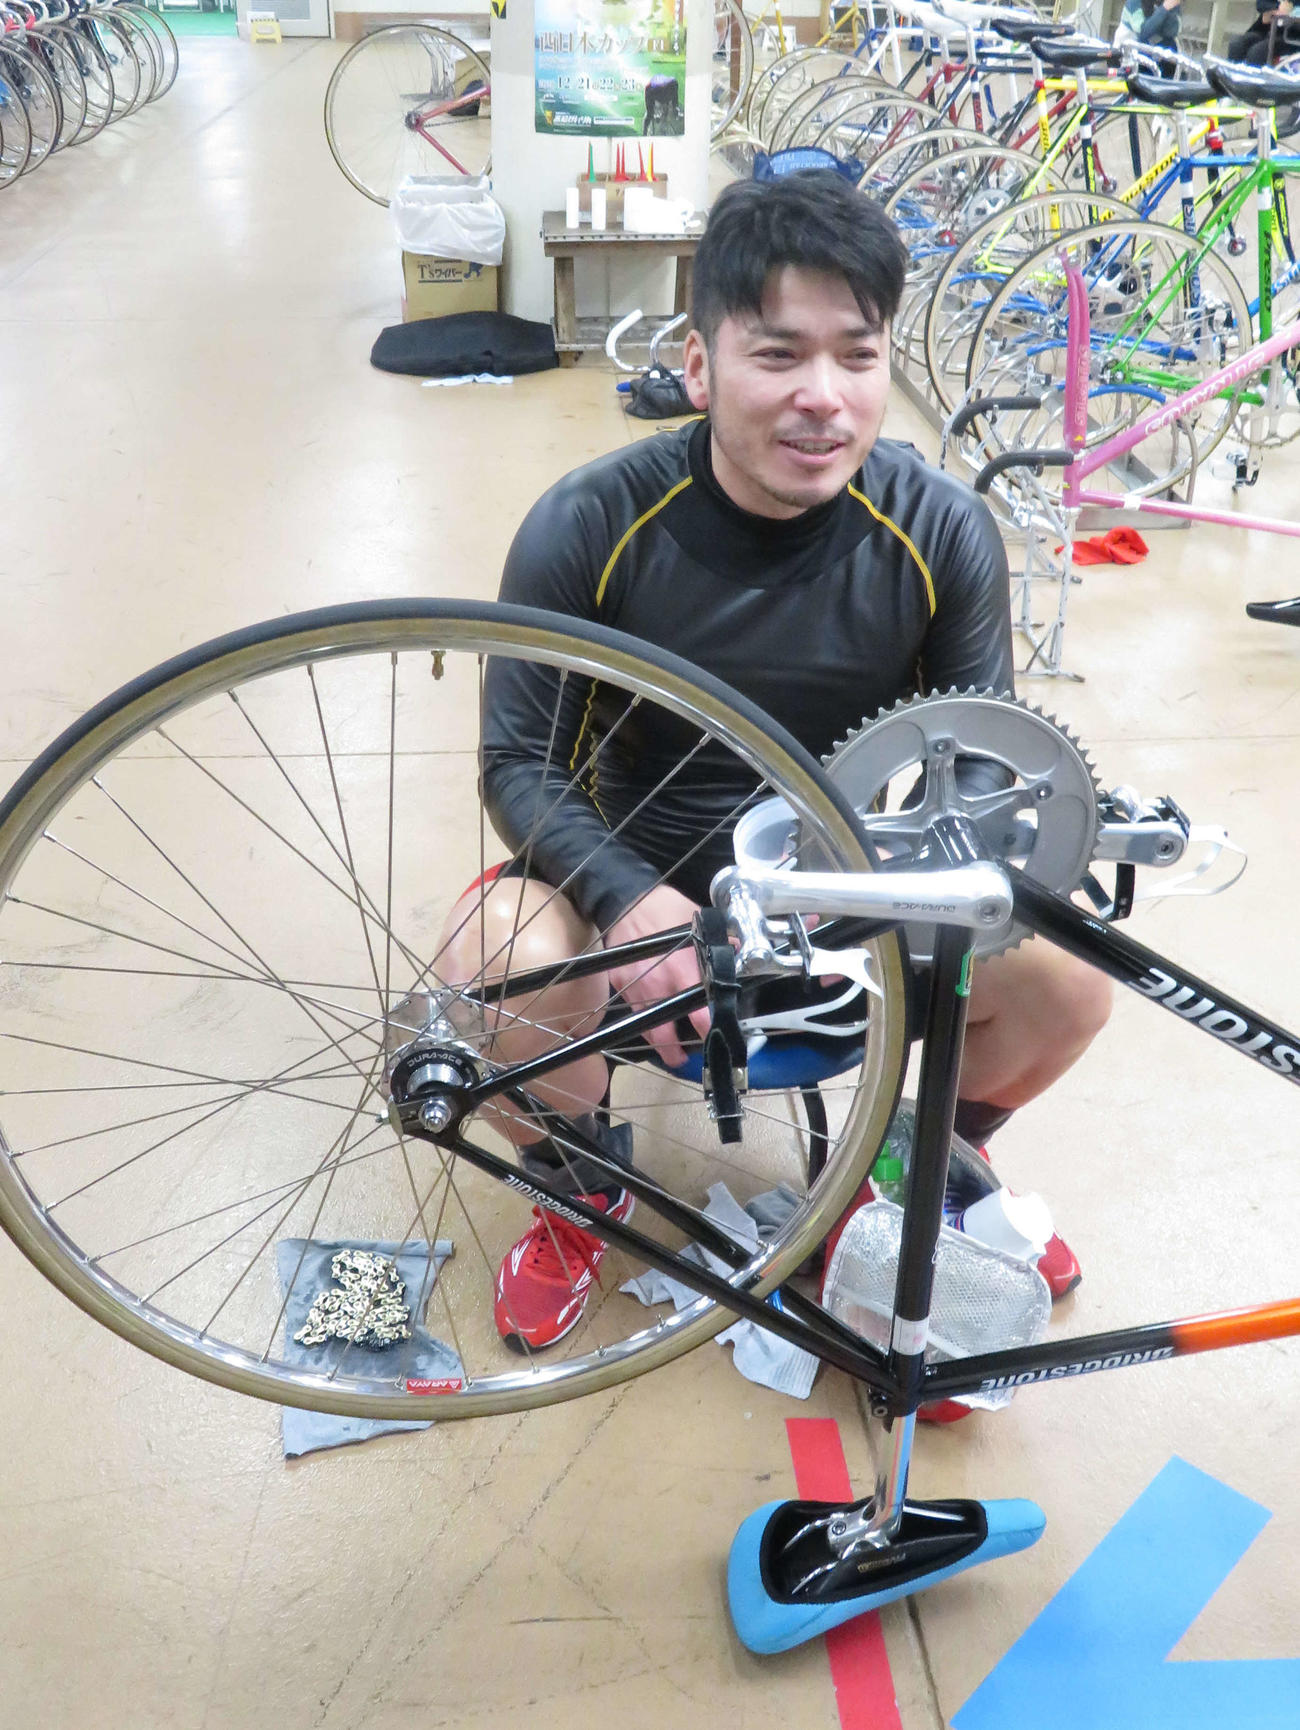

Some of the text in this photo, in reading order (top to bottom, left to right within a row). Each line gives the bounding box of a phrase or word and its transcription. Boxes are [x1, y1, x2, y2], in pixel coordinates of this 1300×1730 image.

[1126, 967, 1300, 1085] STONE
[406, 1052, 463, 1068] DURA-ACE
[504, 1173, 593, 1227] BRIDGESTONE
[409, 1380, 449, 1388] ARAYA
[980, 1346, 1174, 1391] BRIDGESTONE
